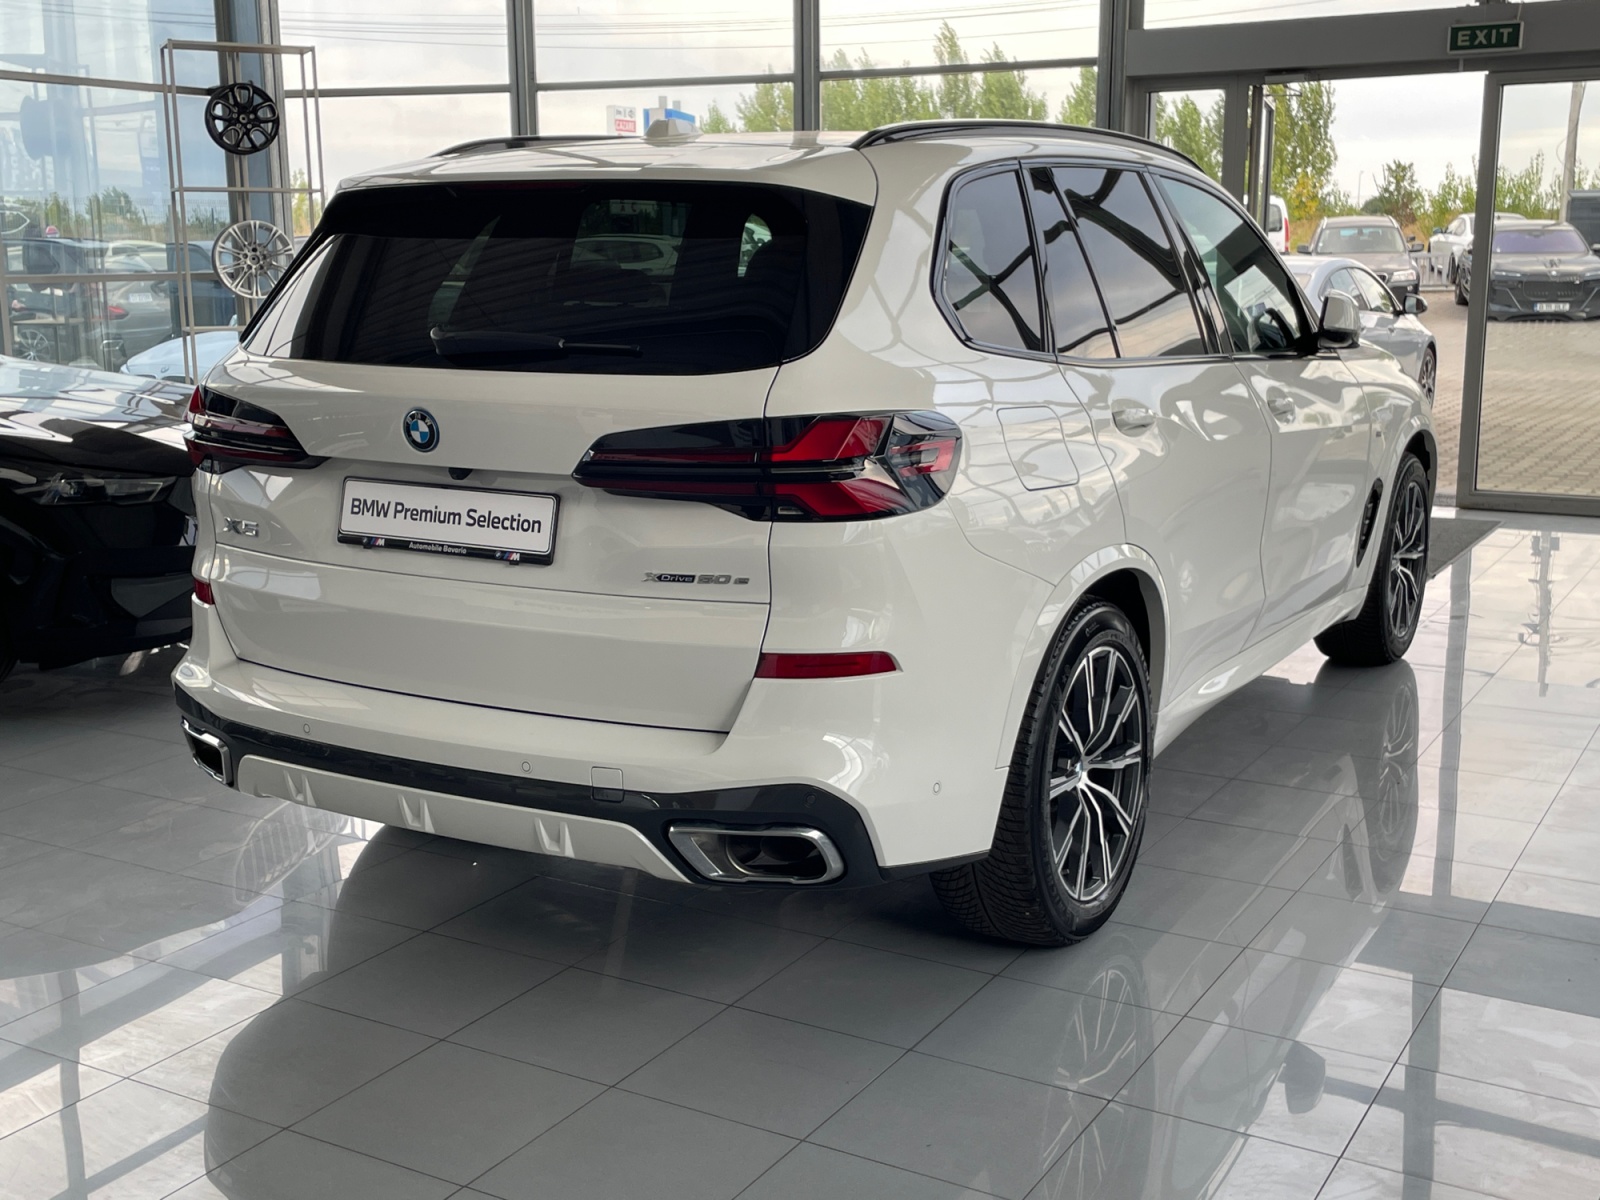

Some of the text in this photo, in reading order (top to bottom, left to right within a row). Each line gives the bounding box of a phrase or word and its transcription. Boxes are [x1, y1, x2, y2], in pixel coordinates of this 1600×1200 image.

[1457, 28, 1513, 46] EXIT
[351, 498, 542, 534] BMW Premium Selection
[223, 516, 259, 538] X5
[409, 541, 467, 554] Automobile Bavaria
